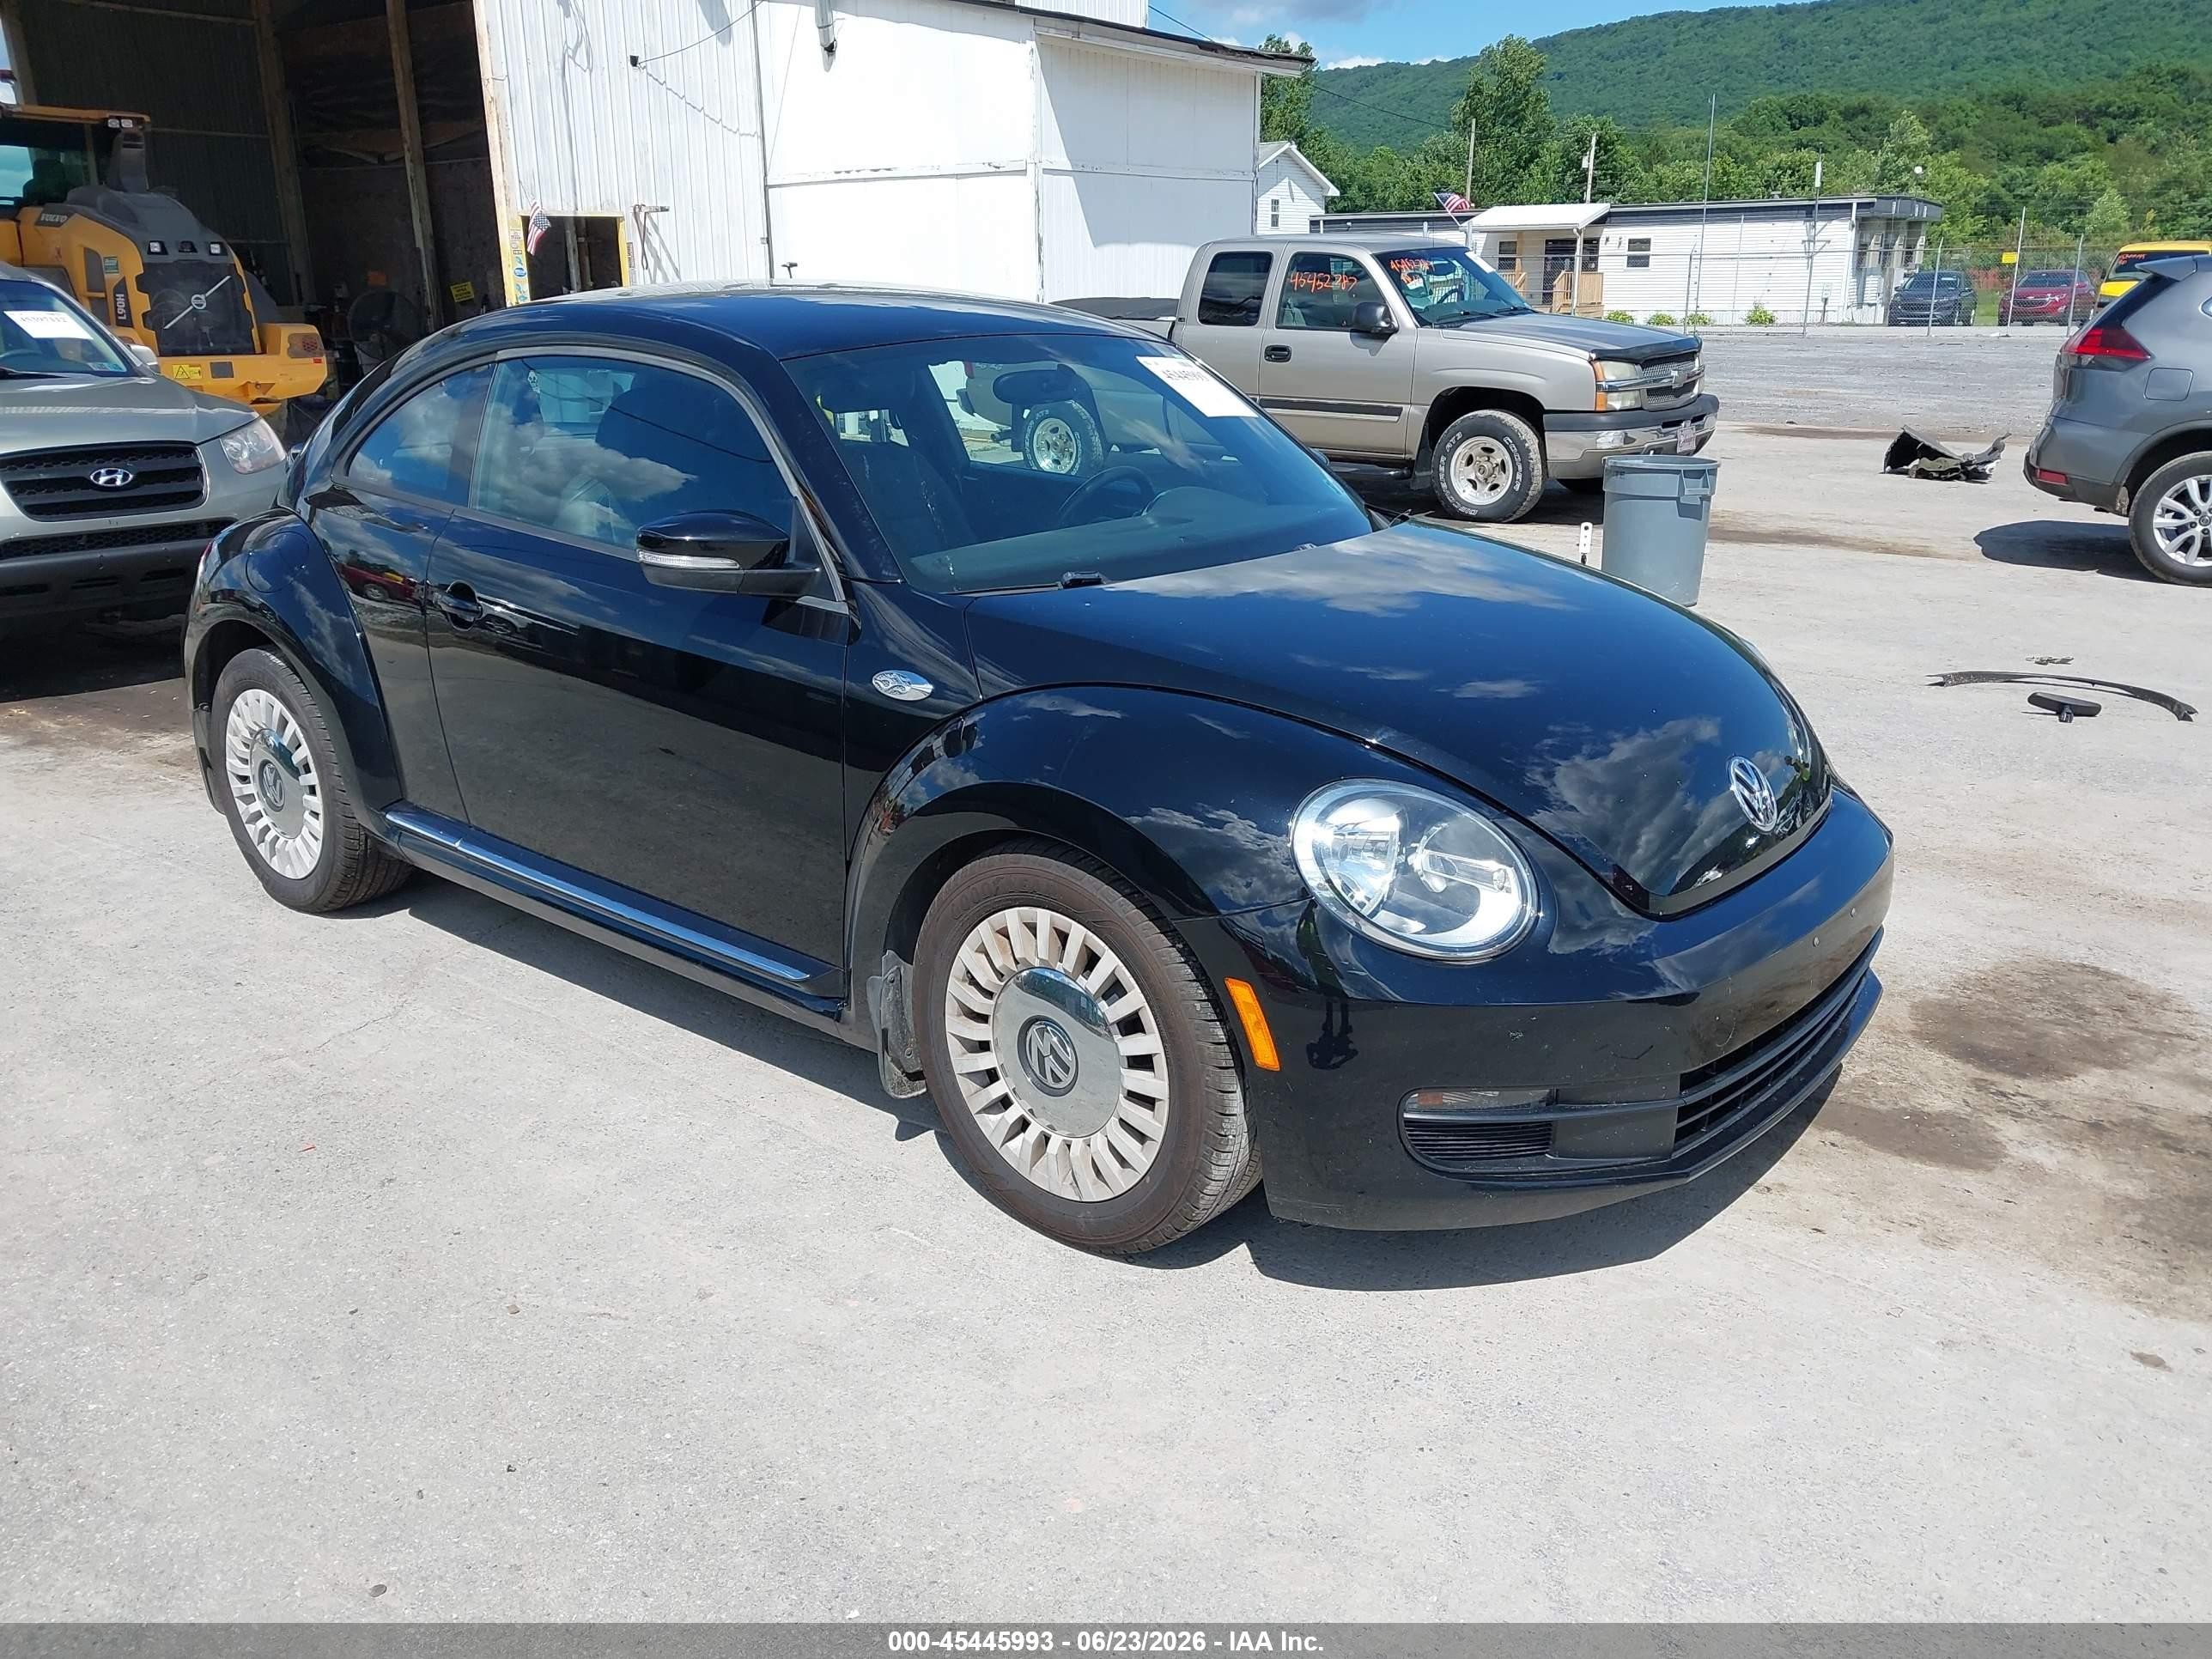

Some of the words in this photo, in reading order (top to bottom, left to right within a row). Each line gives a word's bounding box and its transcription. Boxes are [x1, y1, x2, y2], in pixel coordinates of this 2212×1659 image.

[40, 213, 68, 222] VOLVO
[116, 294, 127, 320] L90H
[1503, 436, 1522, 492] COOPER
